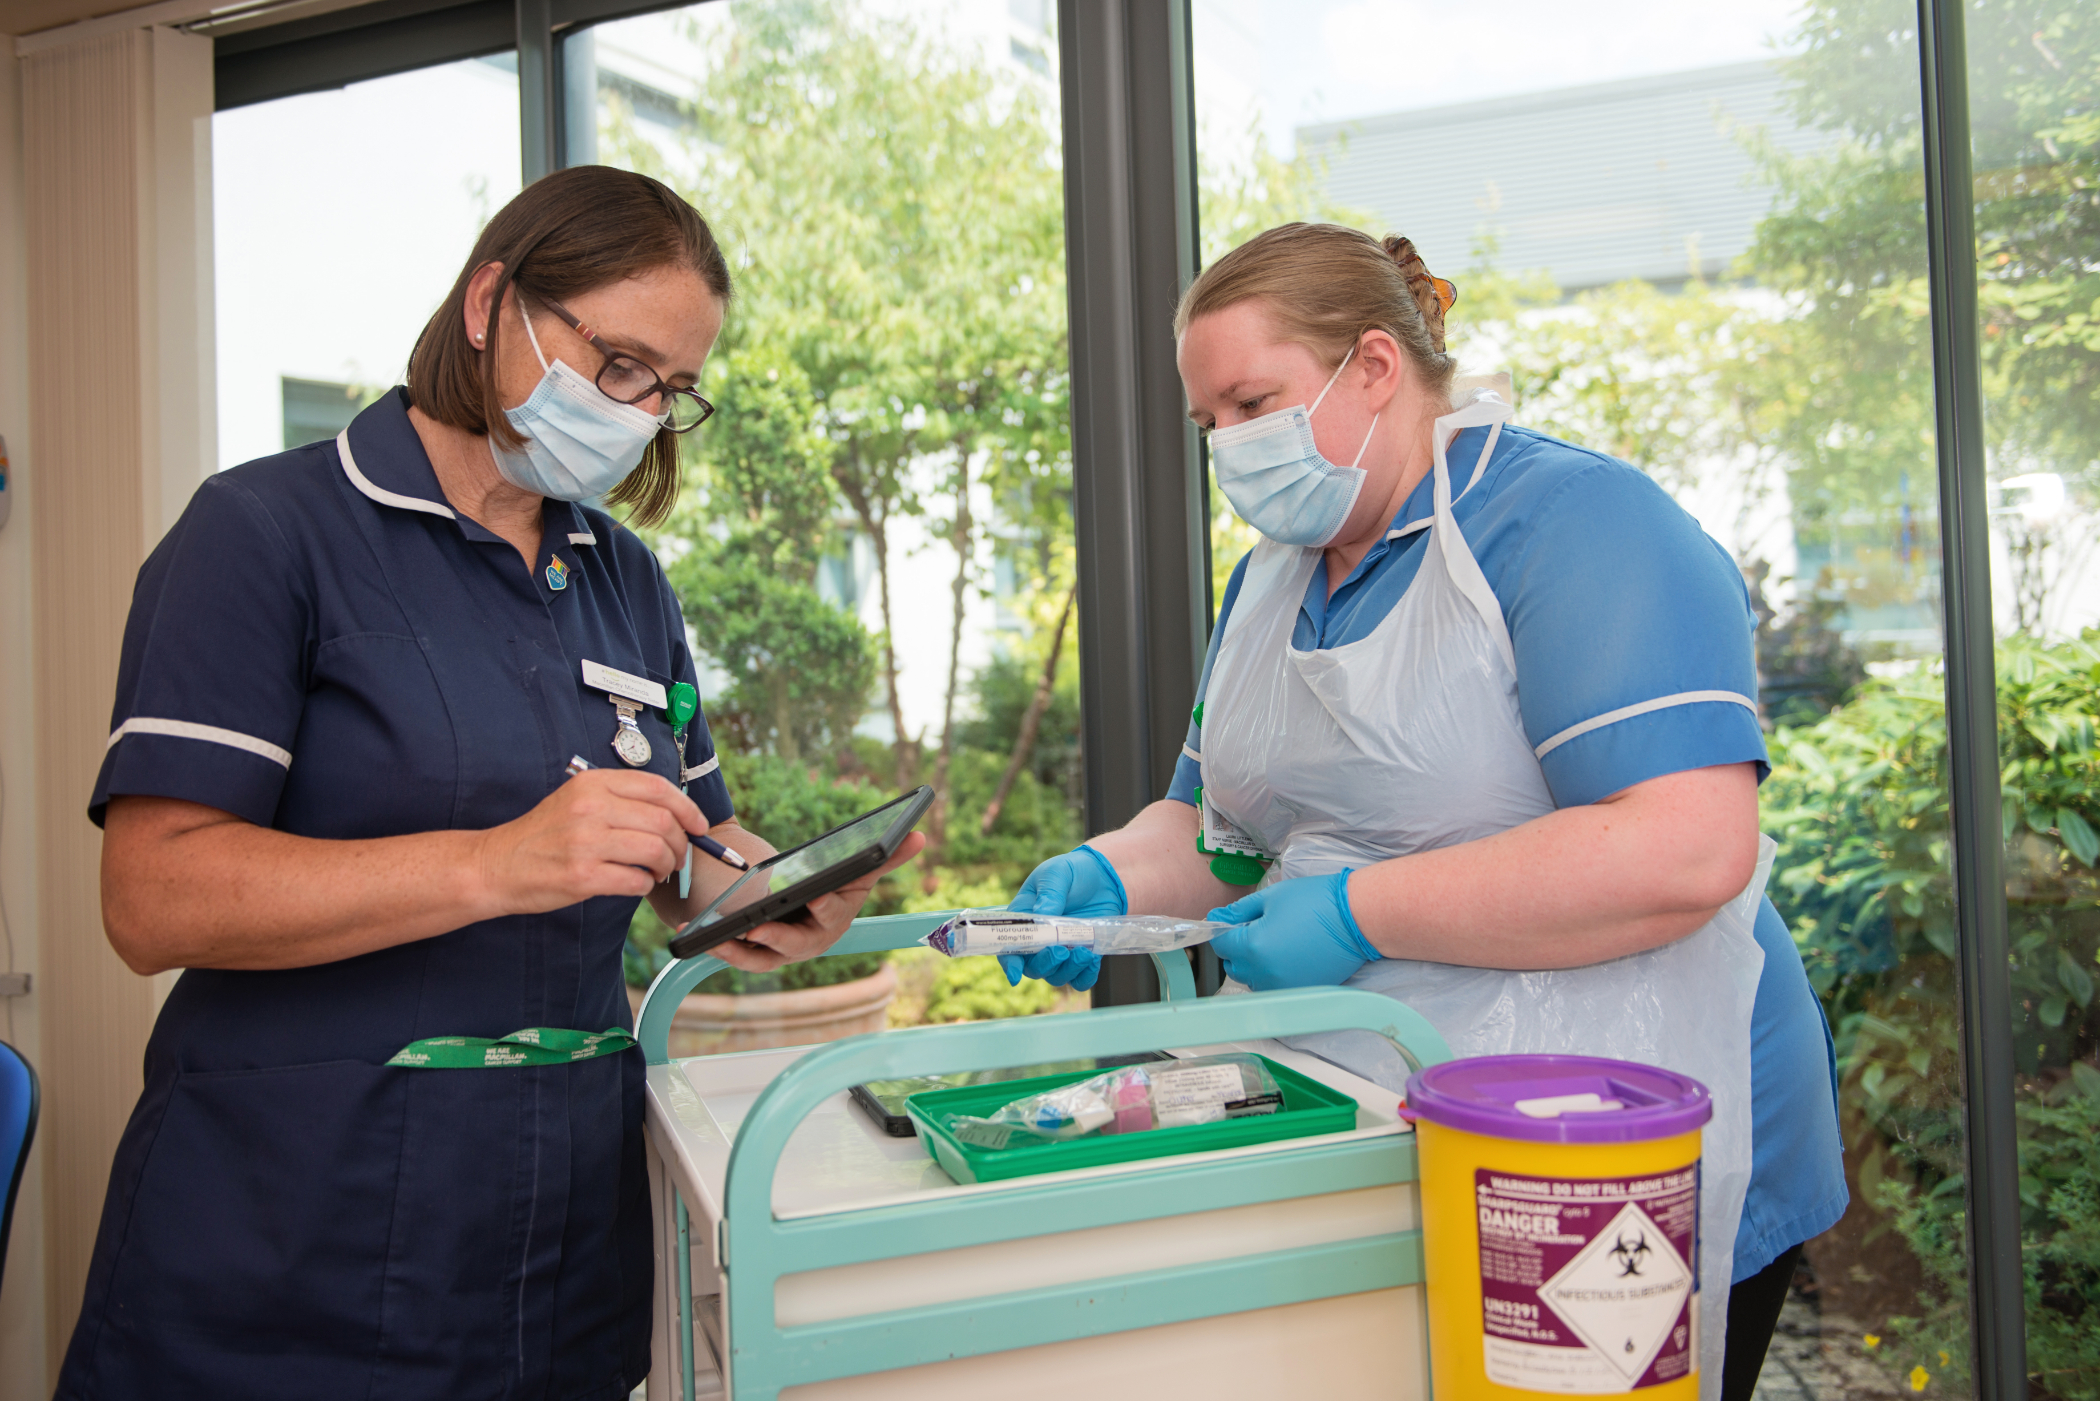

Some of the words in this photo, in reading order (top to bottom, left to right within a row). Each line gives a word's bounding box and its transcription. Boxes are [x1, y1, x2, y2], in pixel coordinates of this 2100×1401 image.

[602, 677, 624, 688] Tracey
[625, 684, 650, 696] Miranda
[1490, 1175, 1551, 1195] WARNING
[1551, 1182, 1572, 1196] DO
[1572, 1183, 1601, 1198] NOT
[1601, 1182, 1627, 1197] FILL
[1628, 1178, 1663, 1194] ABOVE
[1663, 1174, 1679, 1190] THE
[1479, 1206, 1560, 1236] DANGER
[1556, 1288, 1624, 1301] INFECTIOUS
[1628, 1277, 1687, 1299] SUBSTANCES
[1484, 1295, 1539, 1320] UN3291
[1484, 1310, 1512, 1325] Clinical
[1513, 1316, 1539, 1329] Waste
[1624, 1336, 1635, 1354] 6
